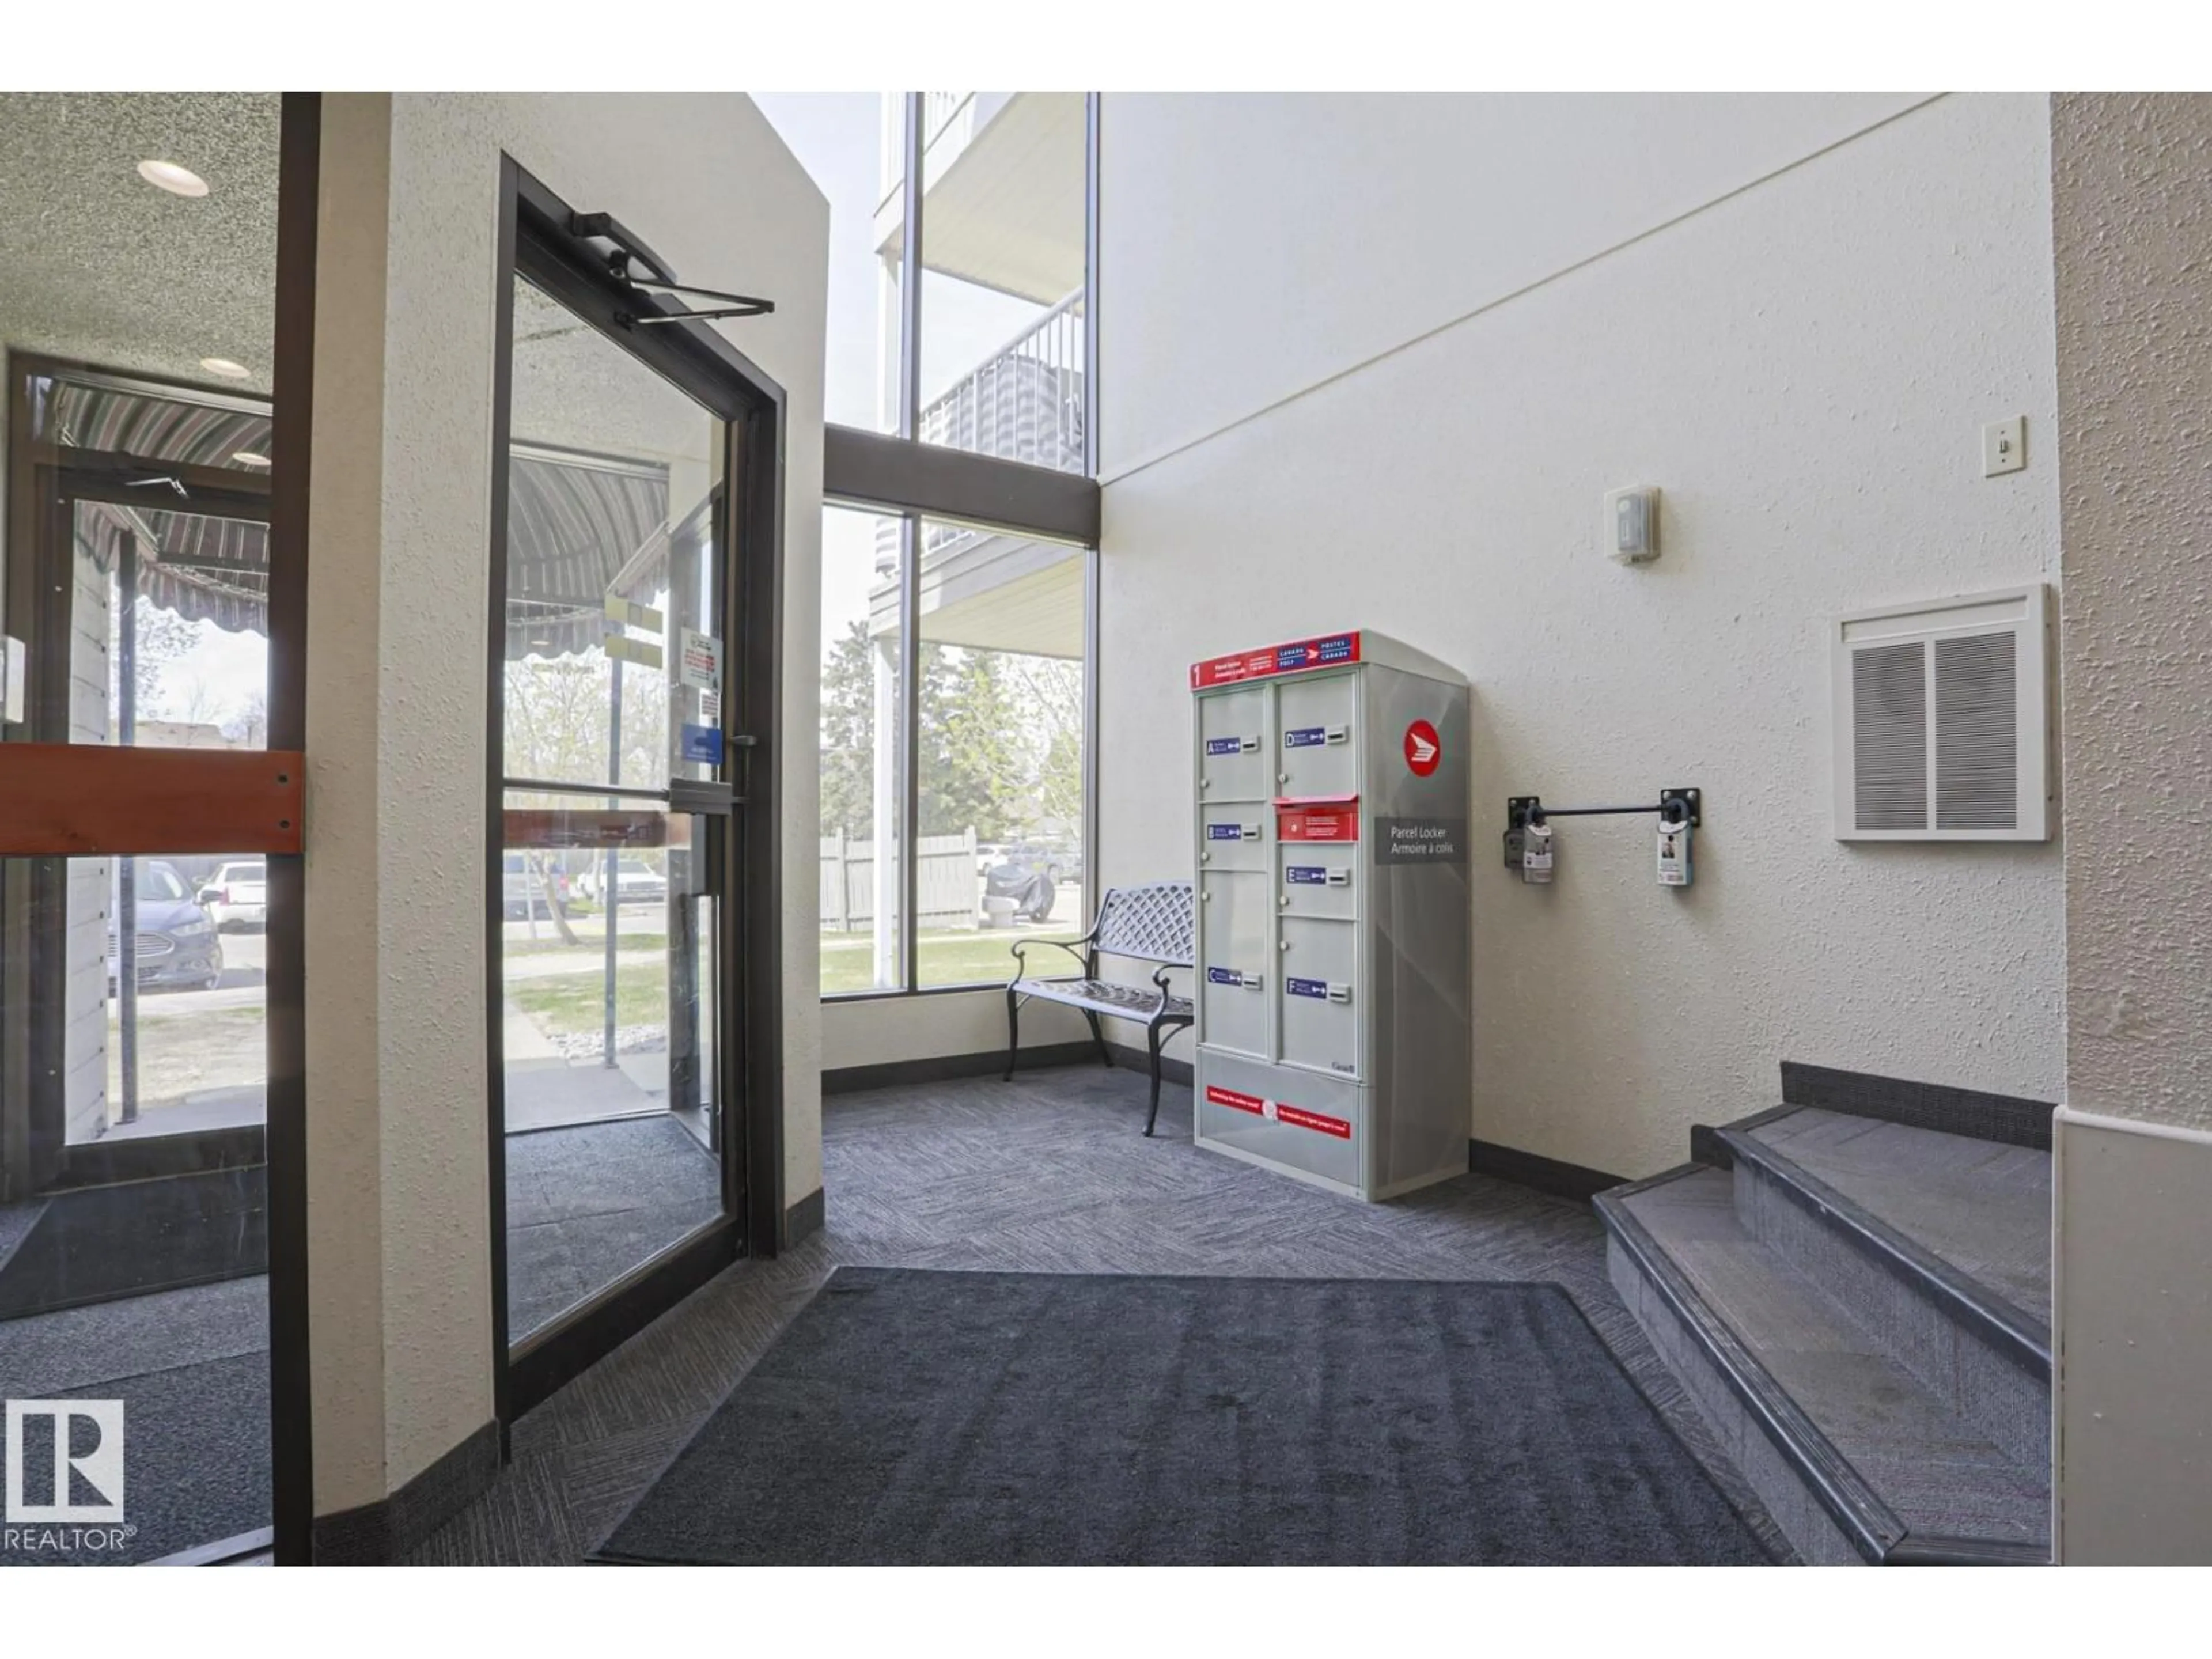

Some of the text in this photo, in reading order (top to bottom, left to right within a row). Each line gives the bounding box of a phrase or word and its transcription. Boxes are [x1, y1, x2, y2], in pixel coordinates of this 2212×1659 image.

[1321, 640, 1345, 649] POSTES
[1279, 647, 1305, 657] CANADA
[1320, 651, 1348, 660] CANADA
[1279, 659, 1294, 667] POST
[1194, 664, 1200, 687] 1
[1286, 733, 1294, 747] D
[1208, 742, 1214, 753] A
[1391, 826, 1446, 839] Parcel Locker
[1391, 842, 1427, 854] Armoire
[1435, 842, 1453, 854] colis
[1289, 869, 1295, 881] E
[1210, 969, 1216, 983] C
[1289, 980, 1296, 993] F
